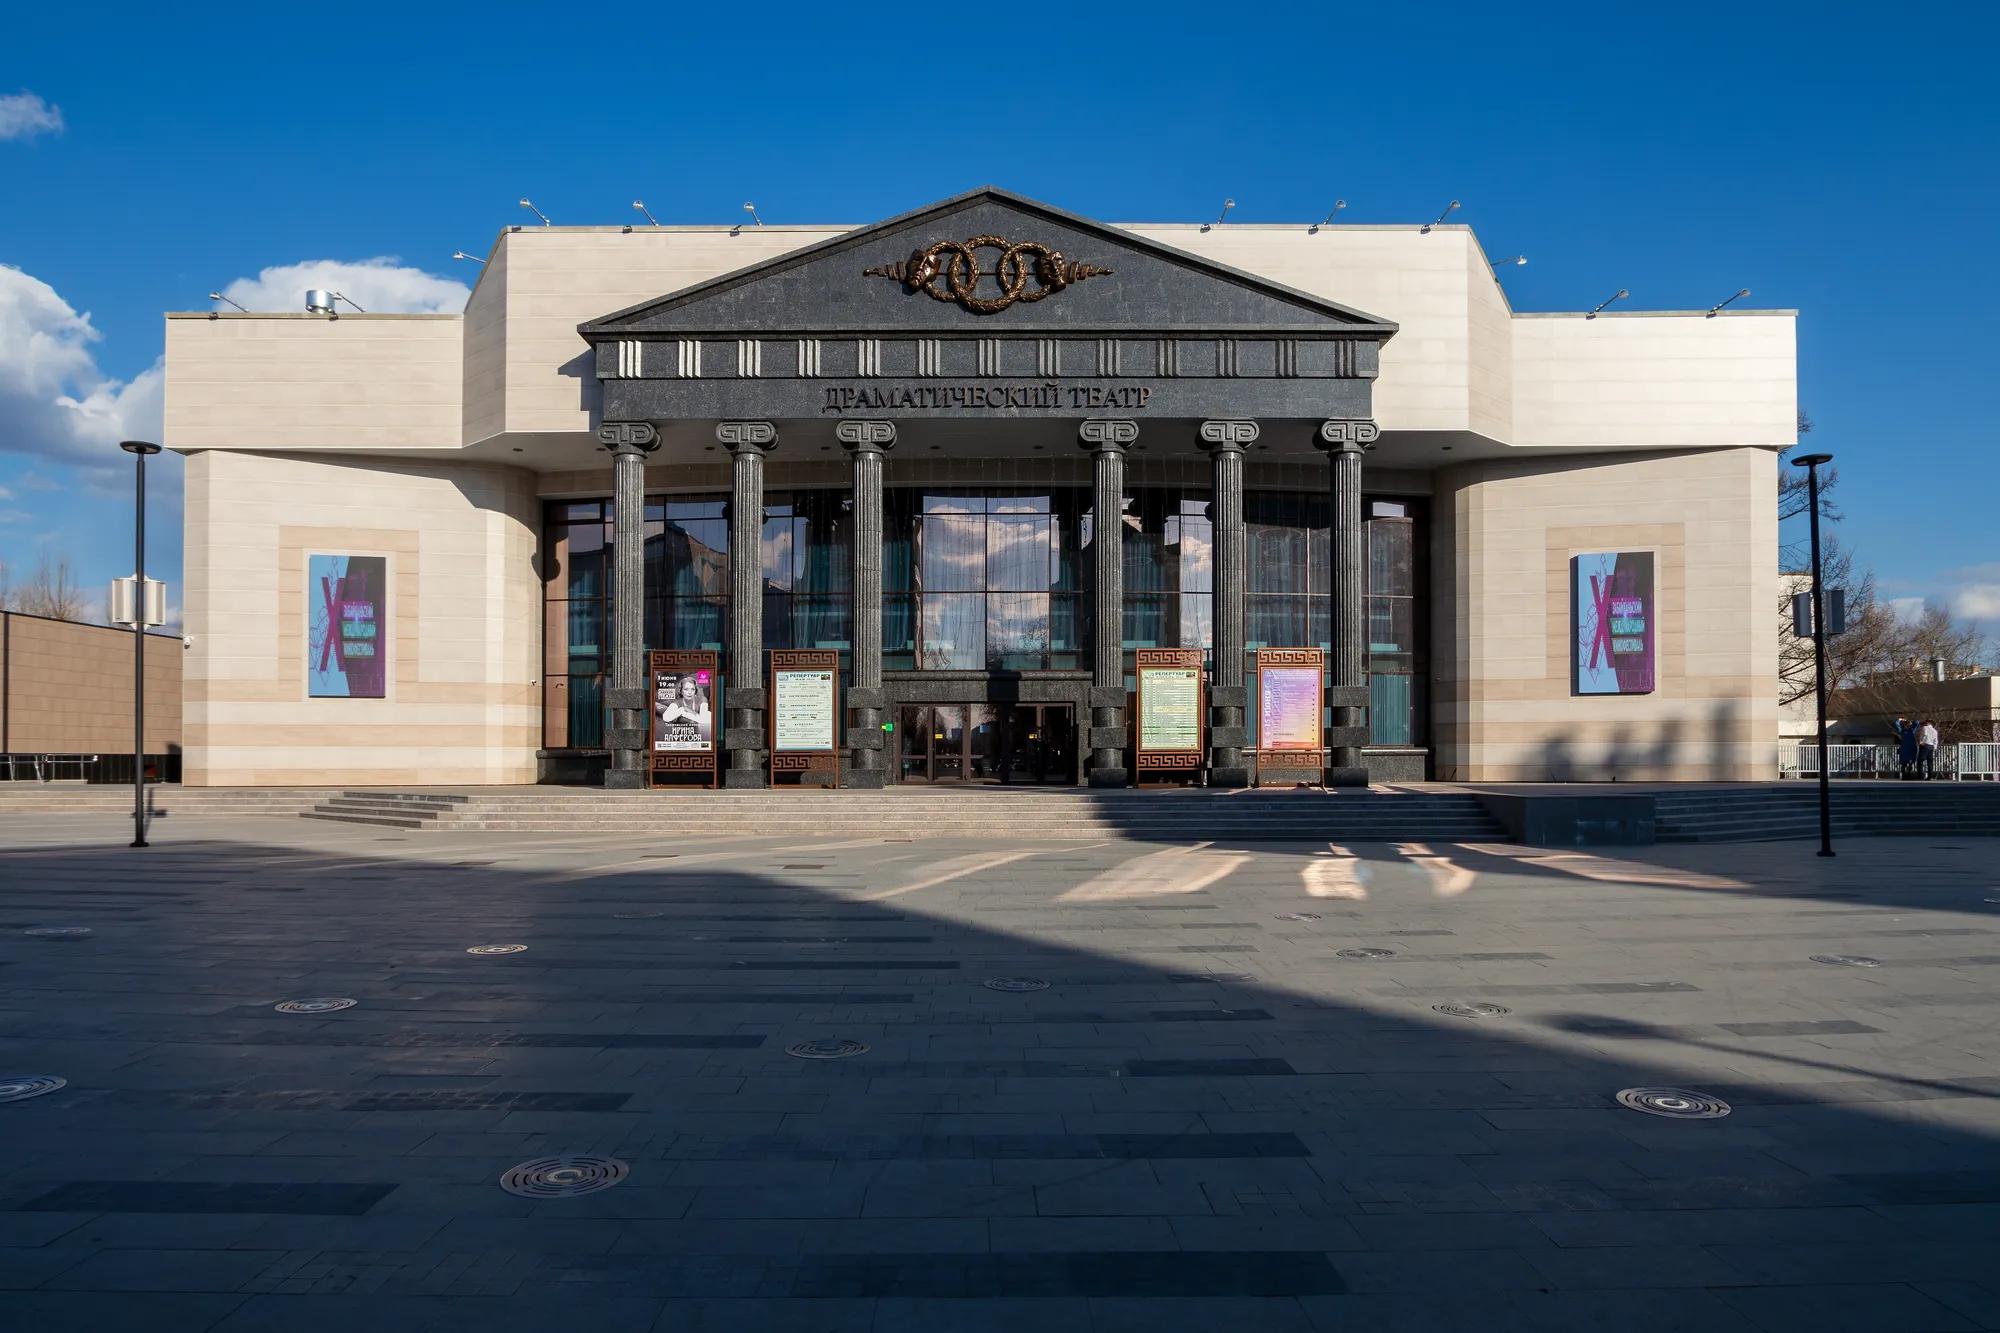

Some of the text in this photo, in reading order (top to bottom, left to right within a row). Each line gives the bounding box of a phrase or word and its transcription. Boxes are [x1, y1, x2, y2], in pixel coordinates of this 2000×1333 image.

[822, 382, 1152, 413] ДРАМАТИЧЕСКИЙ ТЕАТР
[672, 726, 695, 735] ИРИНА
